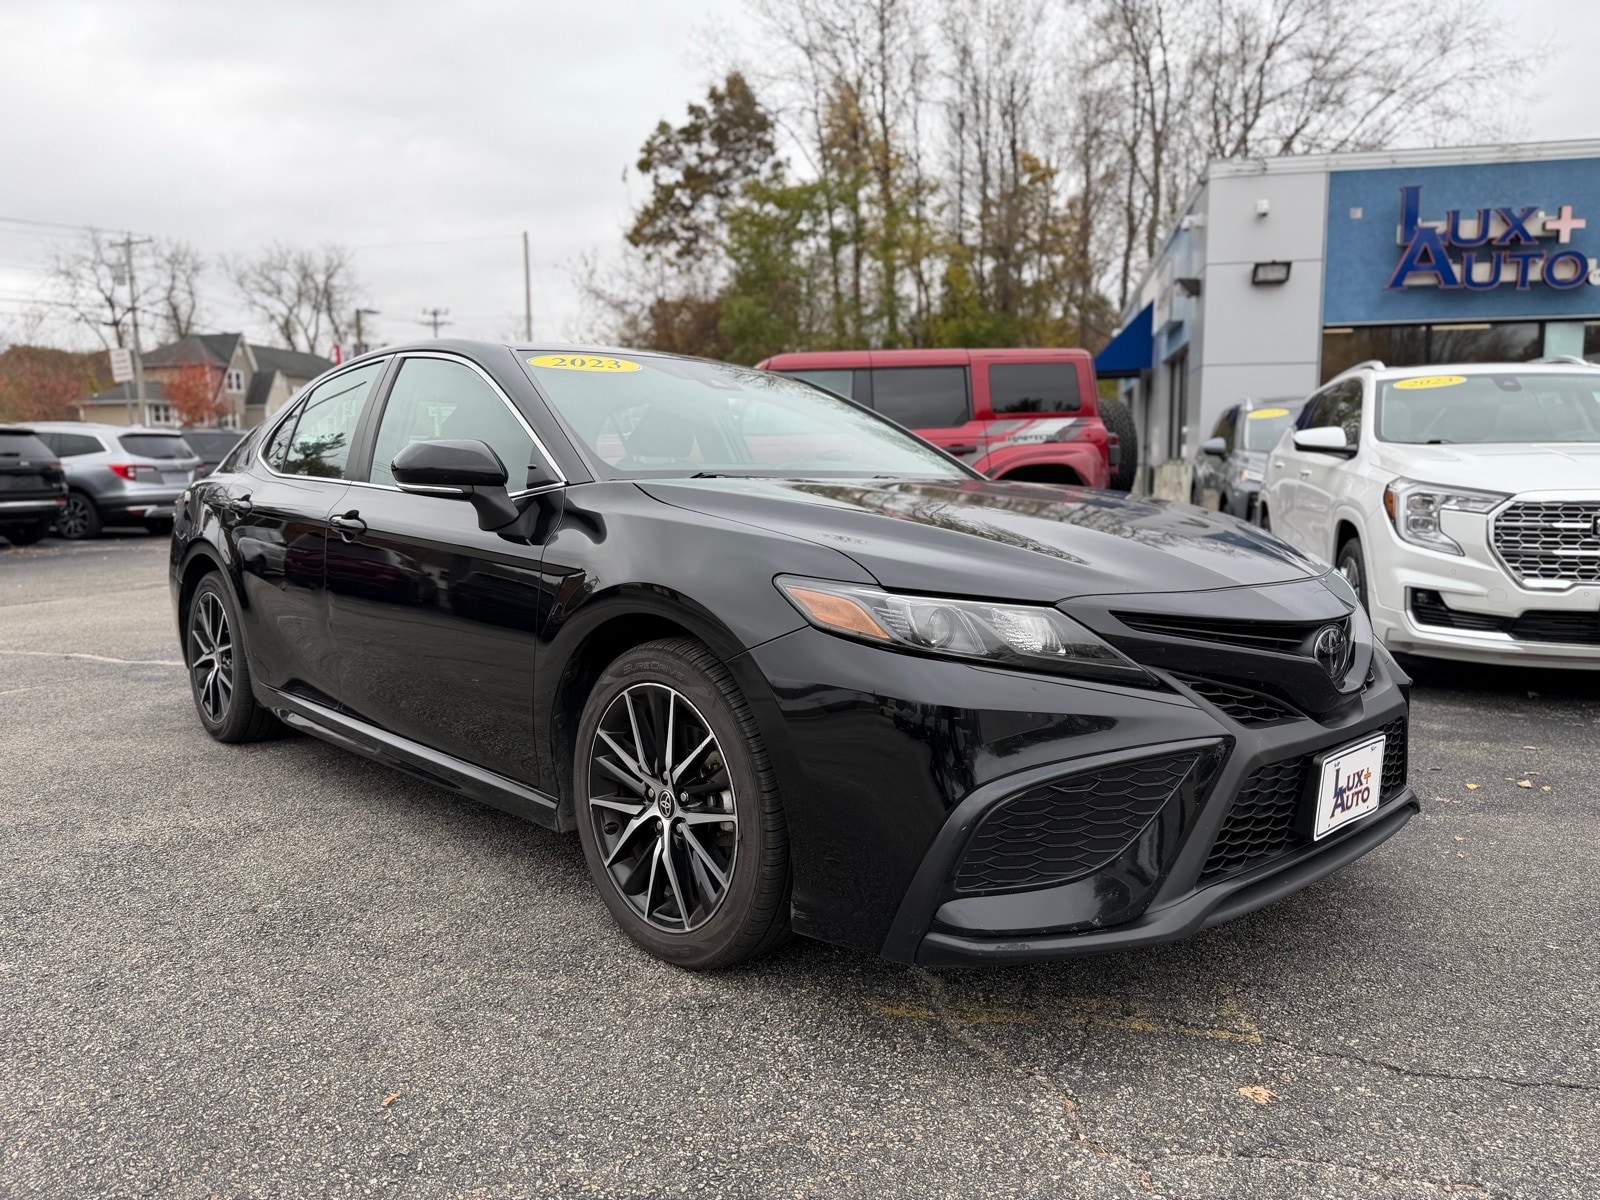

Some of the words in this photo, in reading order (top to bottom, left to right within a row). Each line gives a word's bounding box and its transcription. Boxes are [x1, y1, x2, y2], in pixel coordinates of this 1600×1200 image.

[1383, 226, 1590, 291] AUTO
[551, 357, 622, 369] 2023
[1329, 785, 1371, 819] AUTO
